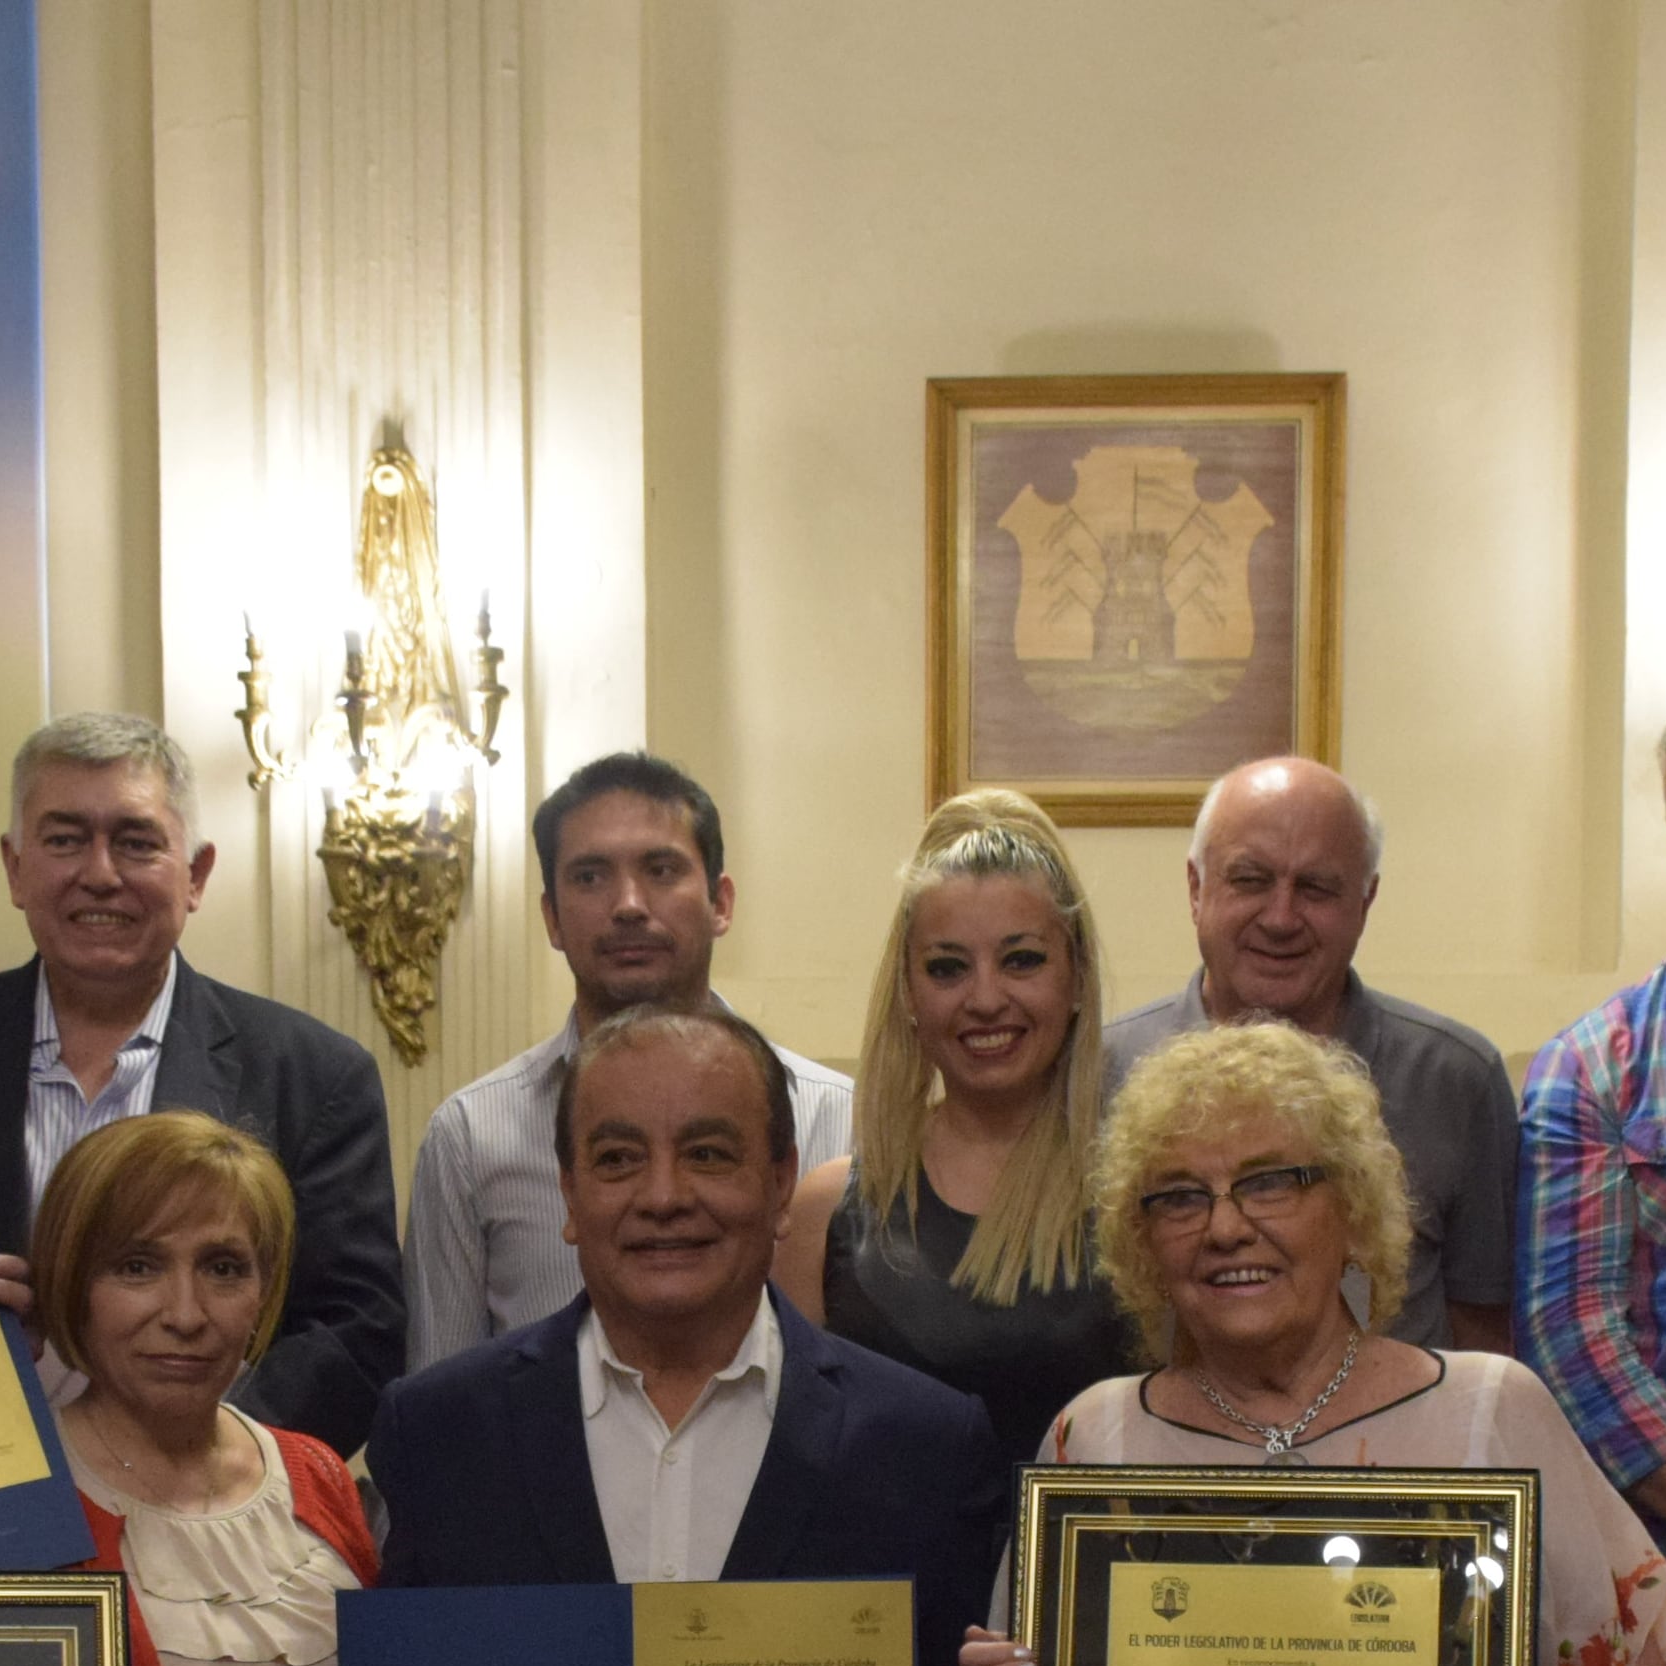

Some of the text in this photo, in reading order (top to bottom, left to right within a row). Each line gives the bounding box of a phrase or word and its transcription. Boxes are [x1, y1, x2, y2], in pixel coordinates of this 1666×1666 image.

[1129, 1634, 1417, 1653] EL PODER LEGISLATIVO DE LA PROVINCIA DE CÓRDOBA
